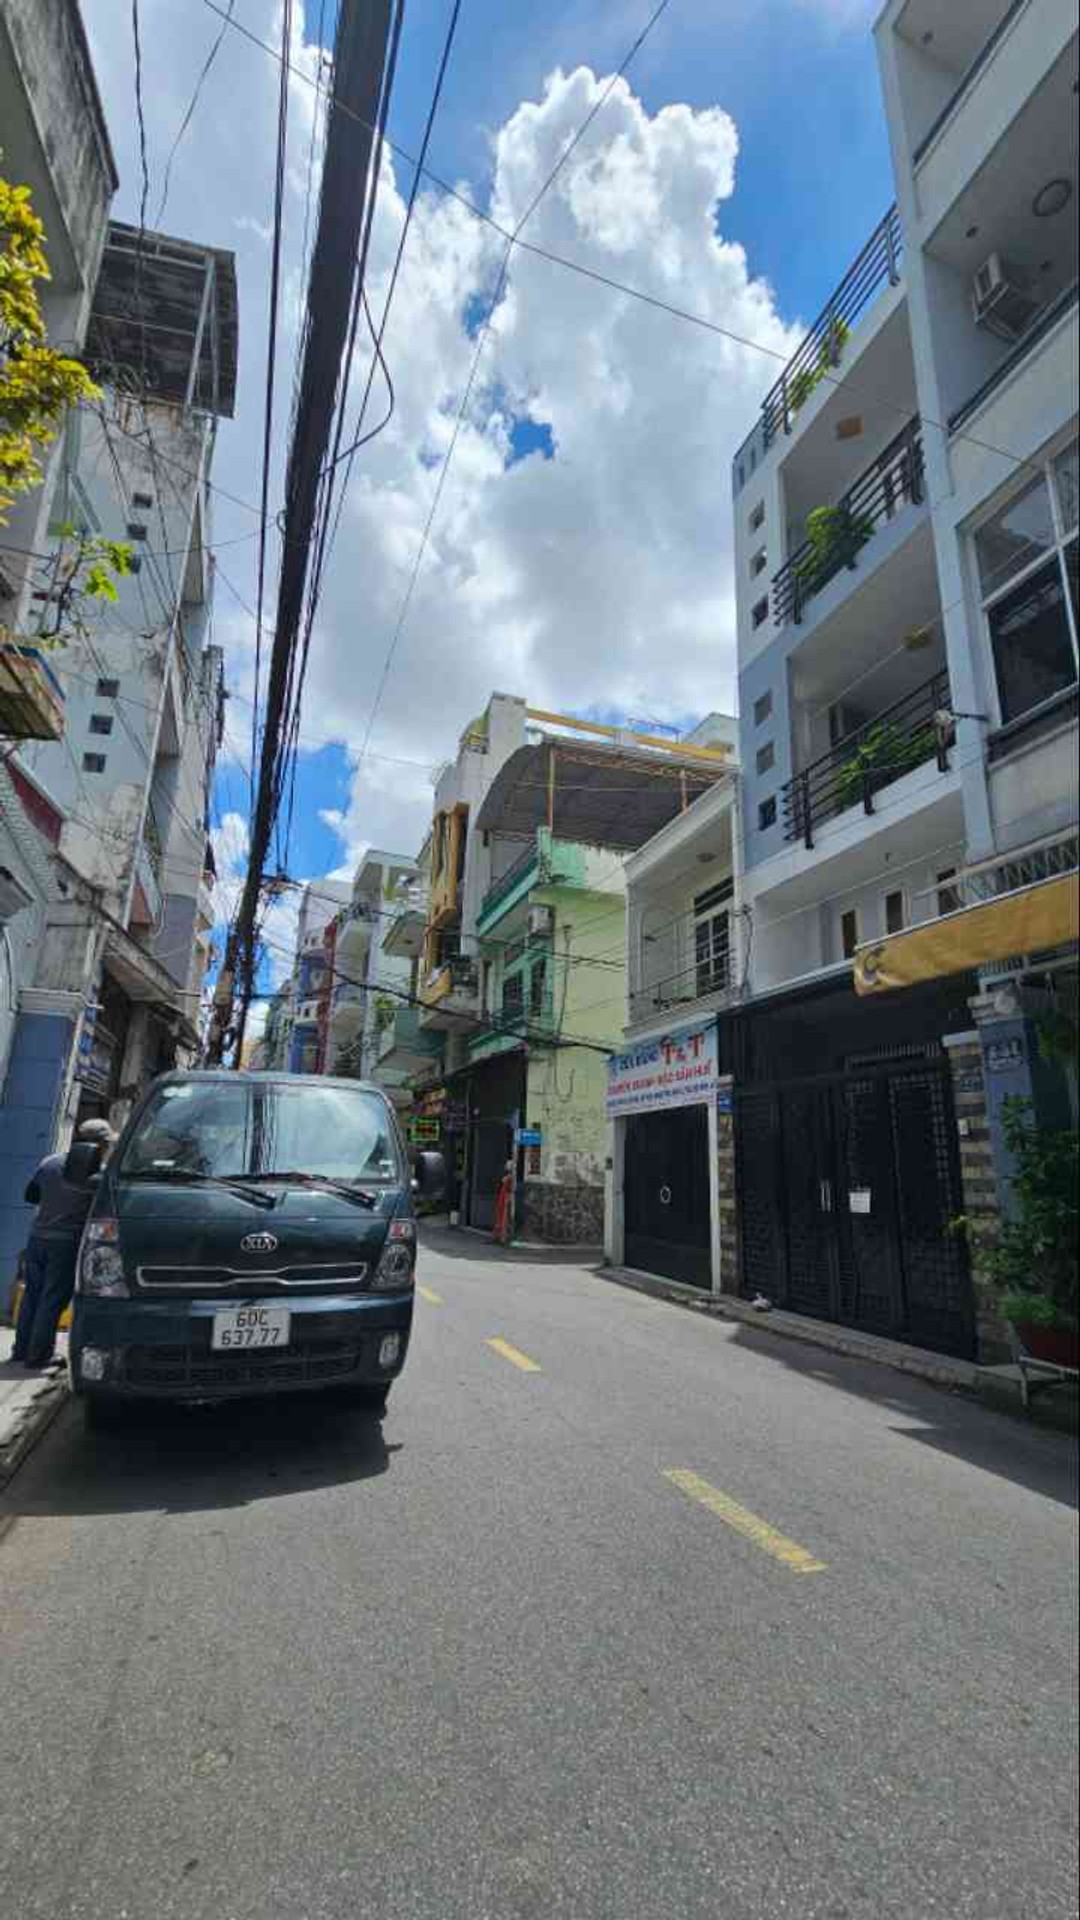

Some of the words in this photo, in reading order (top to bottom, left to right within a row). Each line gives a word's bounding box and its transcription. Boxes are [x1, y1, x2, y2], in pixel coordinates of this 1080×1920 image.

[242, 1237, 276, 1249] KIA
[236, 1308, 268, 1327] 60C
[221, 1327, 281, 1345] 637.77
